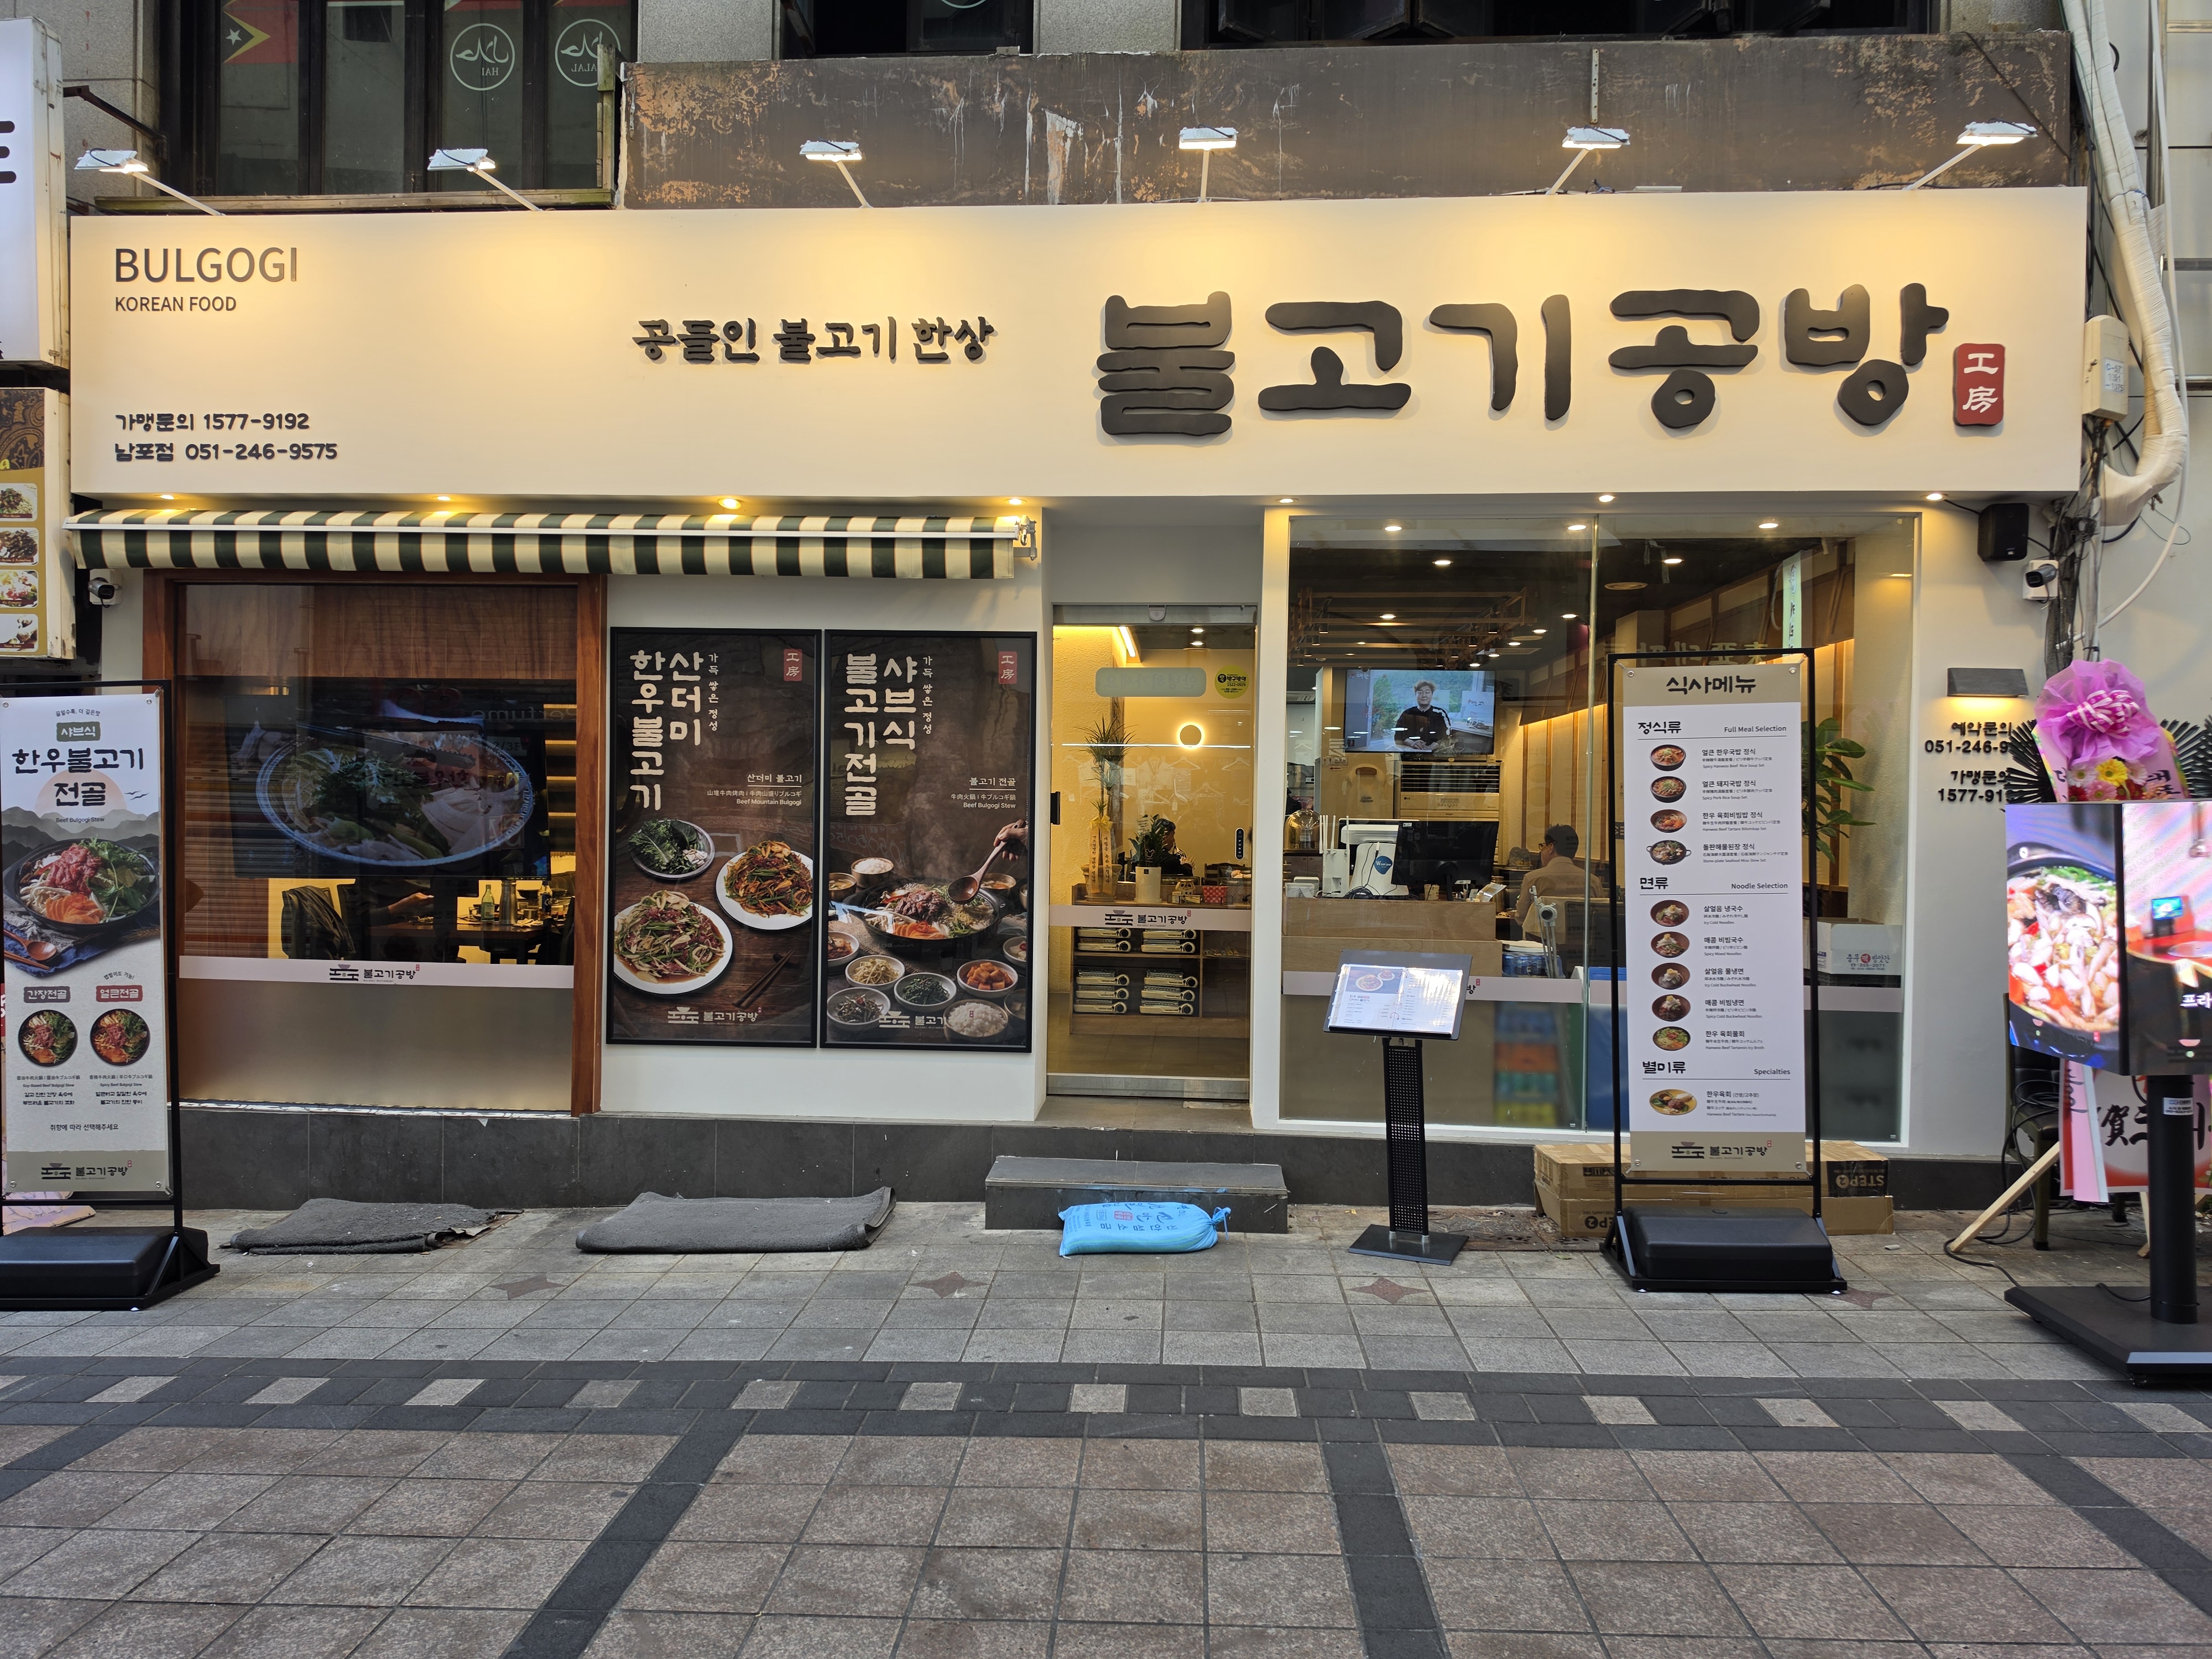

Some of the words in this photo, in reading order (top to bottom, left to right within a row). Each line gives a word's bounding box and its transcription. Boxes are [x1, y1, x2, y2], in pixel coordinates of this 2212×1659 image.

[114, 247, 298, 283] BULGOGI
[114, 296, 184, 312] KOREAN
[189, 296, 237, 312] FOOD
[632, 317, 760, 361] 공들인
[774, 316, 897, 363] 불고기
[911, 316, 995, 361] 한상
[1095, 283, 1950, 437] 불고기공방
[1963, 351, 2000, 416] 工房
[114, 413, 194, 433] 가맹문의
[203, 413, 310, 431] 1577-9192
[114, 442, 175, 462] 남포점
[185, 442, 338, 461] 051-246-9575
[708, 653, 718, 675] 가득
[785, 652, 800, 678] 工房
[922, 655, 933, 678] 가득
[1000, 655, 1015, 680] 工房
[708, 681, 718, 703] 쌓은
[922, 684, 933, 706] 쌓은
[1666, 675, 1756, 695] 식사메뉴
[669, 651, 703, 746] 산더미
[883, 656, 918, 750] 샤브식
[708, 709, 718, 731] 정성
[922, 712, 932, 734] 정성
[1637, 721, 1682, 735] 정식류
[1951, 721, 2012, 737] 예약문의
[61, 726, 96, 737] 샤브식
[630, 650, 666, 811] 한우불고기
[844, 653, 879, 816] 불고기전골
[1924, 739, 2009, 753] 051-246-9
[12, 748, 144, 774] 한우불고기
[747, 774, 773, 783] 산더미
[775, 774, 802, 783] 불고기
[969, 777, 996, 786] 불고기
[998, 777, 1016, 786] 전골
[54, 781, 106, 807] 전골
[1938, 788, 2002, 802] 1577-91
[1640, 877, 1669, 890] 면류
[1138, 914, 1188, 925] 불고기공방
[363, 969, 416, 979] 불고기공방
[27, 989, 67, 1000] 간장전골
[100, 989, 139, 999] 얼큰전골
[703, 1011, 758, 1022] 불고기공방
[1642, 1061, 1686, 1074] 별미류
[83, 1123, 119, 1131] 선택해주세요
[1709, 1146, 1767, 1156] 불고기공방
[76, 1166, 128, 1177] 불고기공방
